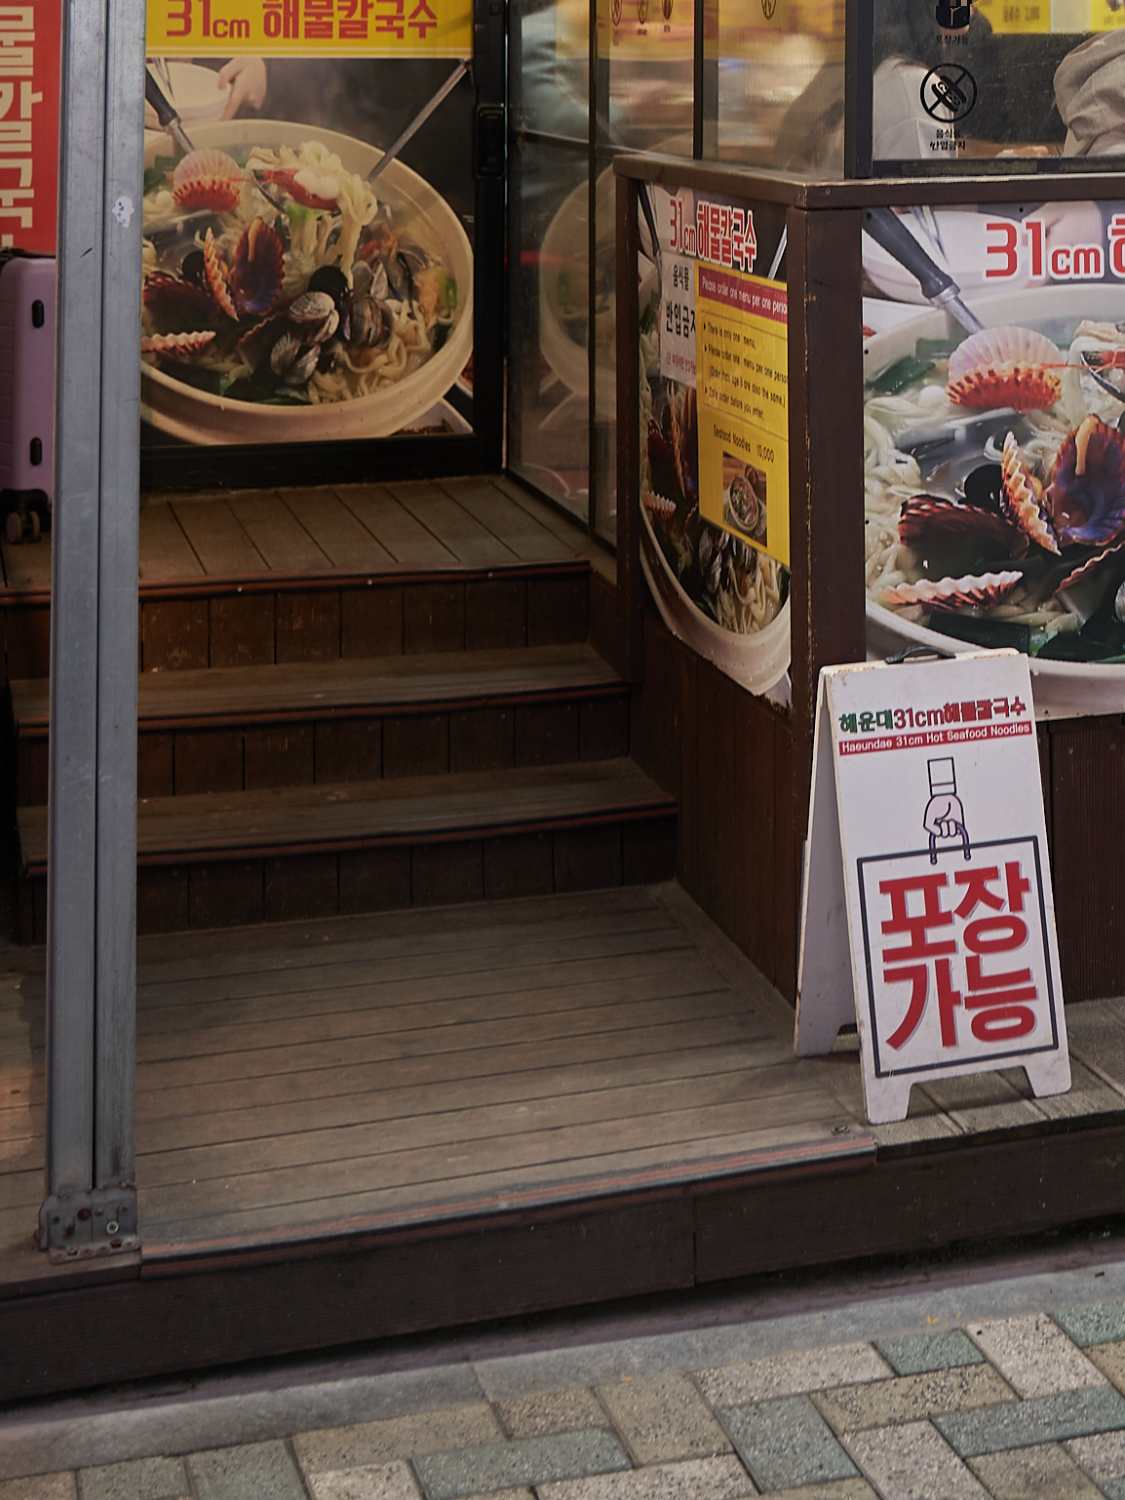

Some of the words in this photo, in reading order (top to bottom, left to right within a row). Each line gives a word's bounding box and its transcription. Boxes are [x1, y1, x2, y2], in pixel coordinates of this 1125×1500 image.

[669, 196, 697, 257] 31cm
[697, 199, 758, 274] 해물칼국수
[984, 218, 1105, 281] 31cm
[729, 287, 739, 301] one
[739, 290, 752, 305] menu
[751, 294, 762, 309] per
[761, 297, 772, 311] one
[841, 739, 893, 754] Haeundae
[895, 735, 923, 747] 31cm
[926, 733, 944, 744] Hot
[946, 728, 988, 742] Seafood
[990, 723, 1031, 737] Noodles
[878, 861, 1031, 964] 포장
[882, 953, 1038, 1051] 가능
